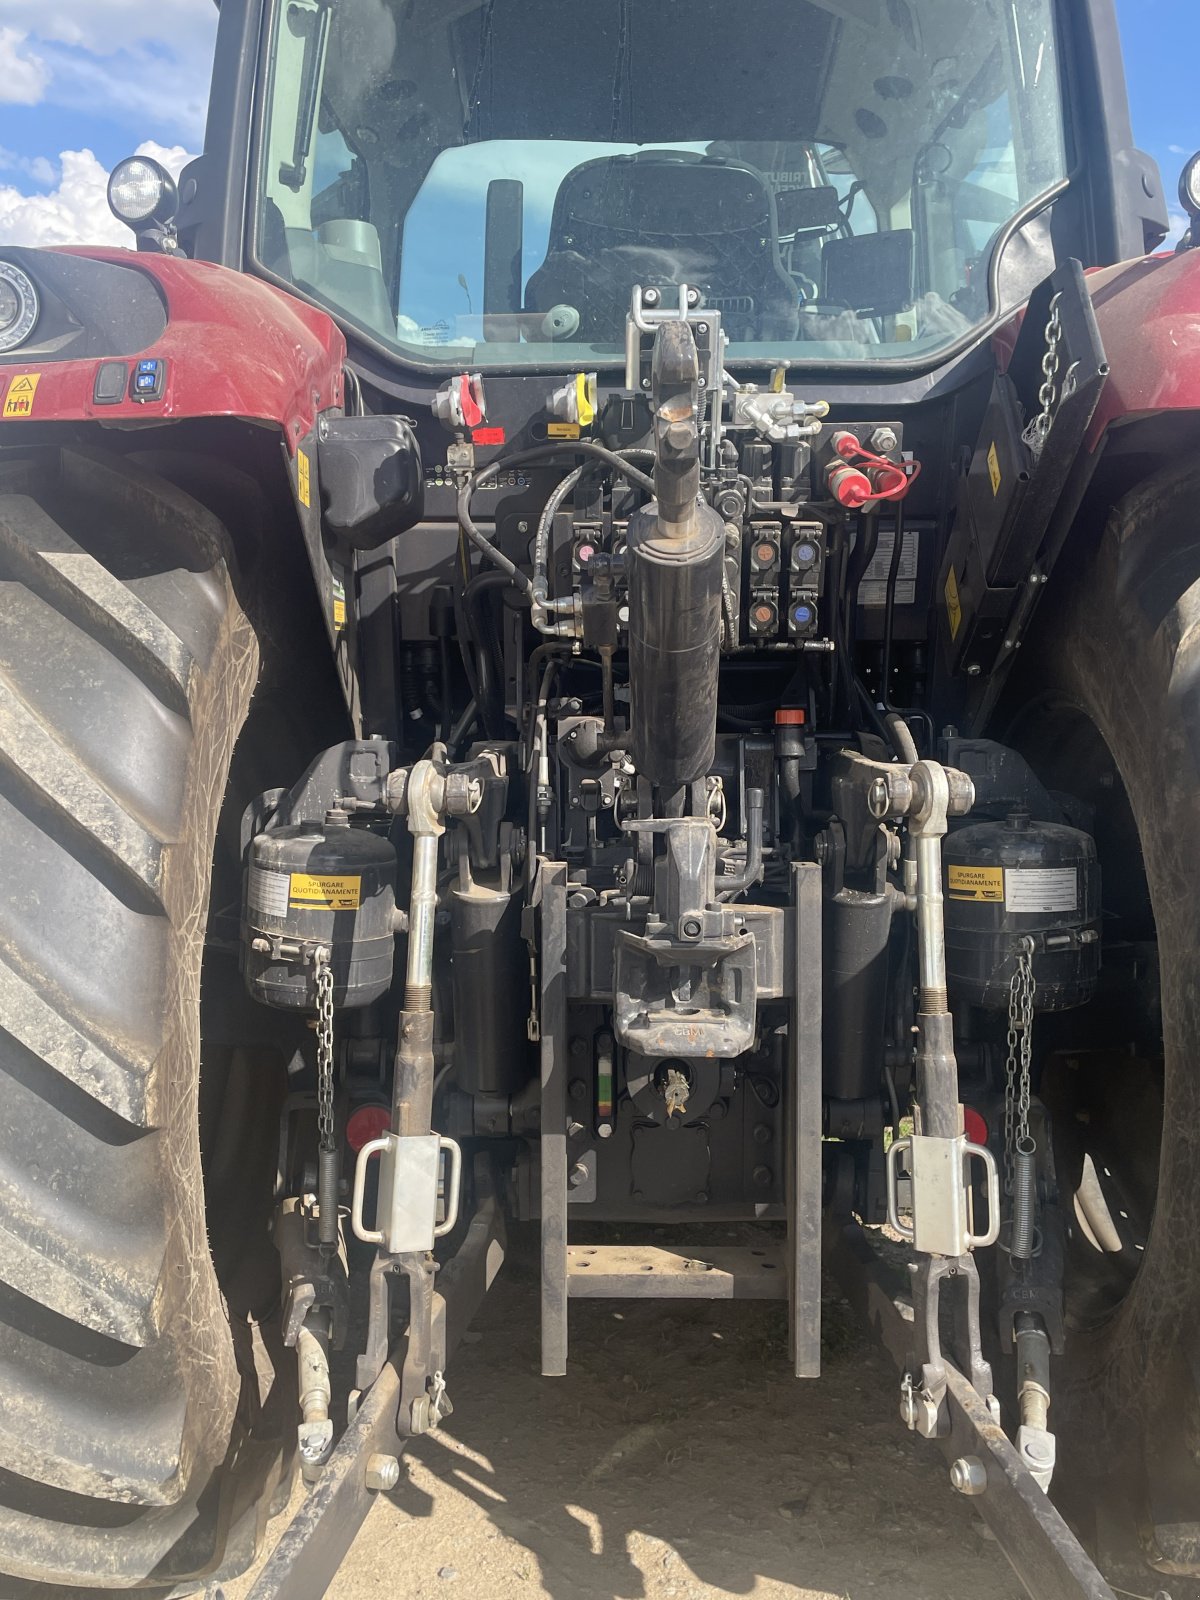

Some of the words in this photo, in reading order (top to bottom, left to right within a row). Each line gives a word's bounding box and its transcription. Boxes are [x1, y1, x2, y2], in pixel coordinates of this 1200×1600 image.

[957, 871, 985, 879] SPURGARE
[308, 881, 345, 889] SPURGARE
[949, 878, 1001, 887] QUOTIDIANAMENTE
[292, 887, 360, 896] QUOTIDIANAMENTE
